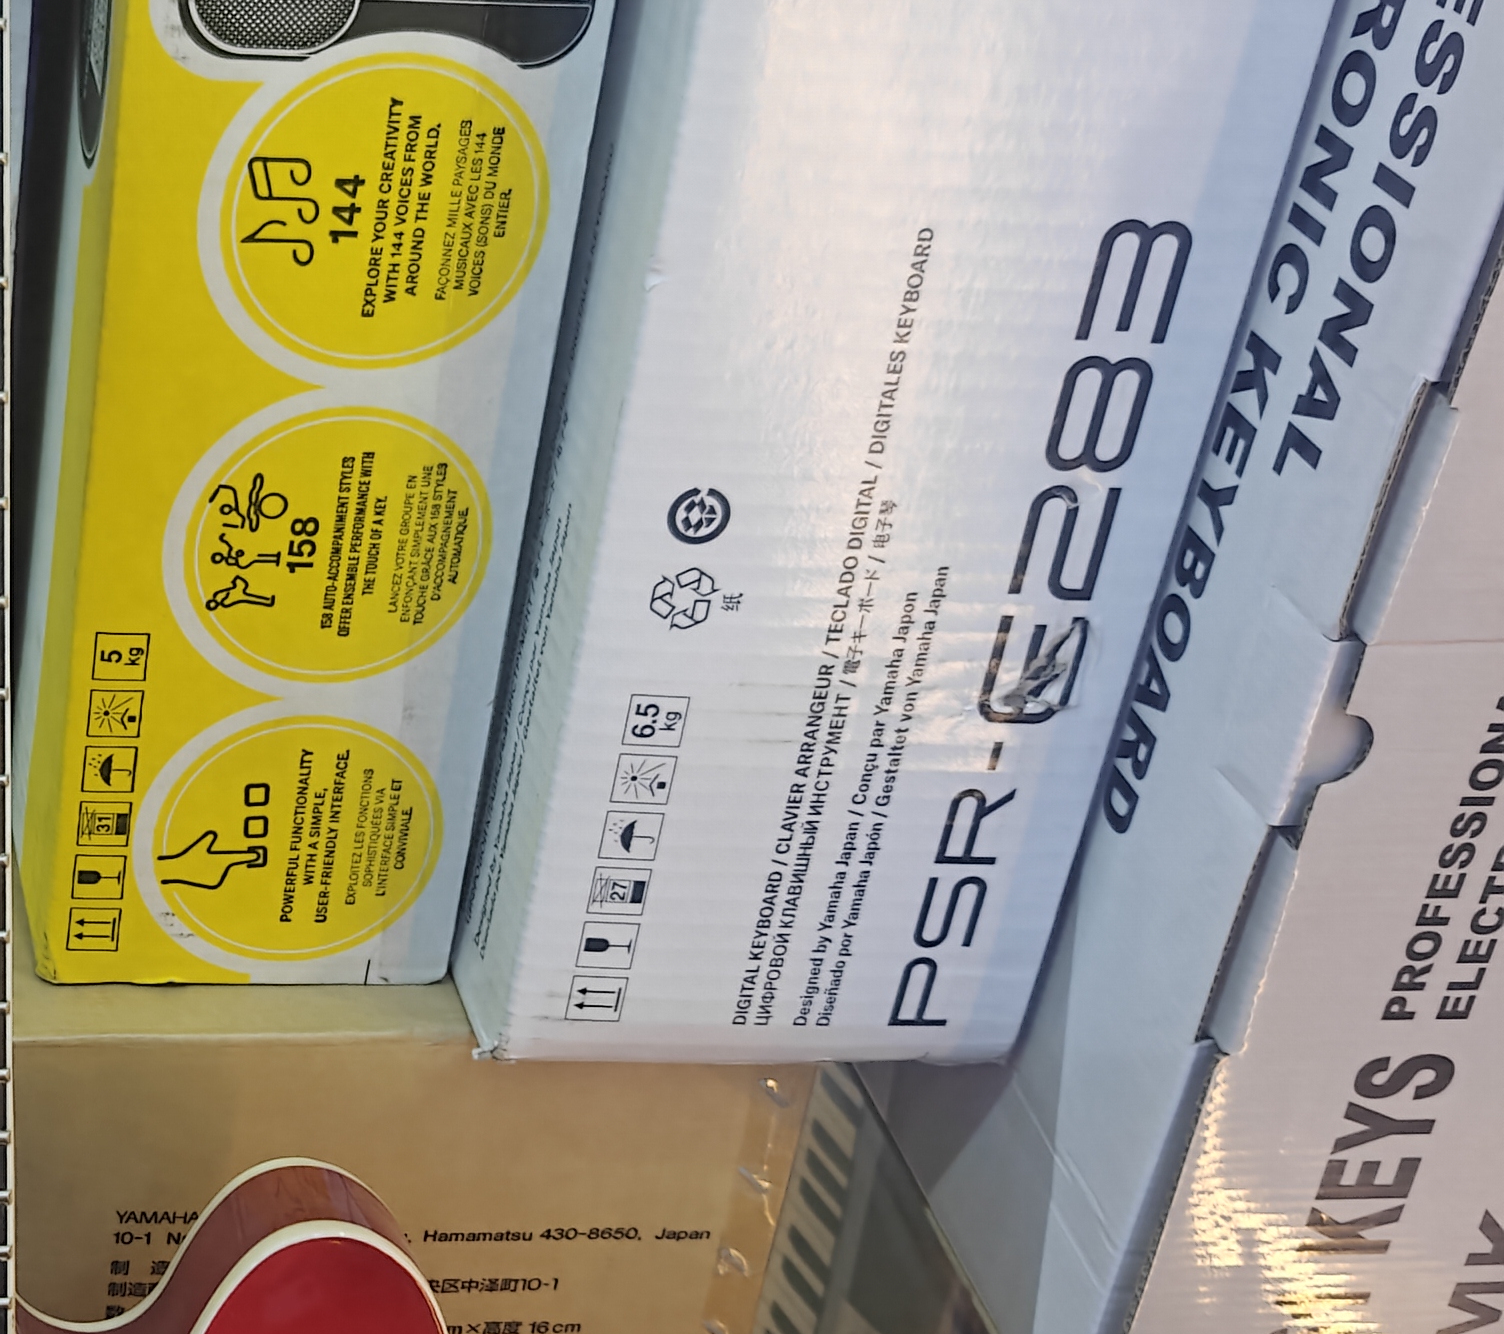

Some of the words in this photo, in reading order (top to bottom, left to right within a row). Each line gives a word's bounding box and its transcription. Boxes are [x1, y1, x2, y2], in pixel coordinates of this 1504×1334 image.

[379, 97, 404, 194] CREATIVITY
[404, 115, 422, 162] FROM
[420, 123, 441, 187] WORLD.
[329, 174, 366, 244] 144
[371, 199, 390, 243] YOUR
[394, 167, 414, 226] VOICES
[415, 192, 431, 223] THE
[390, 231, 404, 258] 144
[405, 227, 425, 297] AROUND
[361, 247, 383, 318] EXPLORE
[383, 263, 400, 303] WITH
[286, 517, 320, 573] 158
[1102, 330, 1283, 835] KEYBOARD
[732, 965, 760, 1025] DIGITAL
[748, 871, 782, 960] KEYBOARD
[775, 783, 806, 854] CLAVIER
[794, 664, 835, 778] ARRANGEUR
[825, 556, 858, 645] TECLADO
[846, 475, 878, 550] DIGITAL
[868, 350, 907, 454] DIGITALES
[893, 227, 934, 343] KEYBOARD
[887, 218, 1194, 1028] PSR-E283
[892, 592, 918, 643] Japon
[100, 649, 123, 664] 5
[124, 646, 144, 666] kg
[873, 649, 905, 716] Yamaha
[631, 702, 661, 740] 6.5
[659, 710, 683, 733] kg
[870, 720, 886, 748] par
[851, 753, 879, 805] Conçu
[279, 854, 299, 922] POWERFUL
[290, 749, 314, 851] FUNCTIONALITY
[309, 788, 328, 837] SIMPLE,
[314, 827, 338, 923] USER-FRIENDLY
[329, 749, 350, 823] INTERFACE.
[303, 854, 317, 885] WITH
[308, 841, 319, 850] A
[754, 933, 792, 1025] ЦИФРОВОЙ
[778, 821, 821, 928] КЛАВИШНЫЙ
[807, 693, 851, 815] ИНСТРУМЕНТ
[835, 822, 860, 867] Japan
[1381, 695, 1504, 1021] PROFESSION
[610, 881, 628, 902] 27
[817, 872, 846, 931] Yamaha
[811, 936, 832, 953] by
[792, 958, 824, 1026] Designed
[1296, 1053, 1455, 1255] KEYS
[113, 1232, 151, 1245] 10-1
[423, 1230, 533, 1242] Hamamatsu
[654, 1227, 711, 1242] Japan
